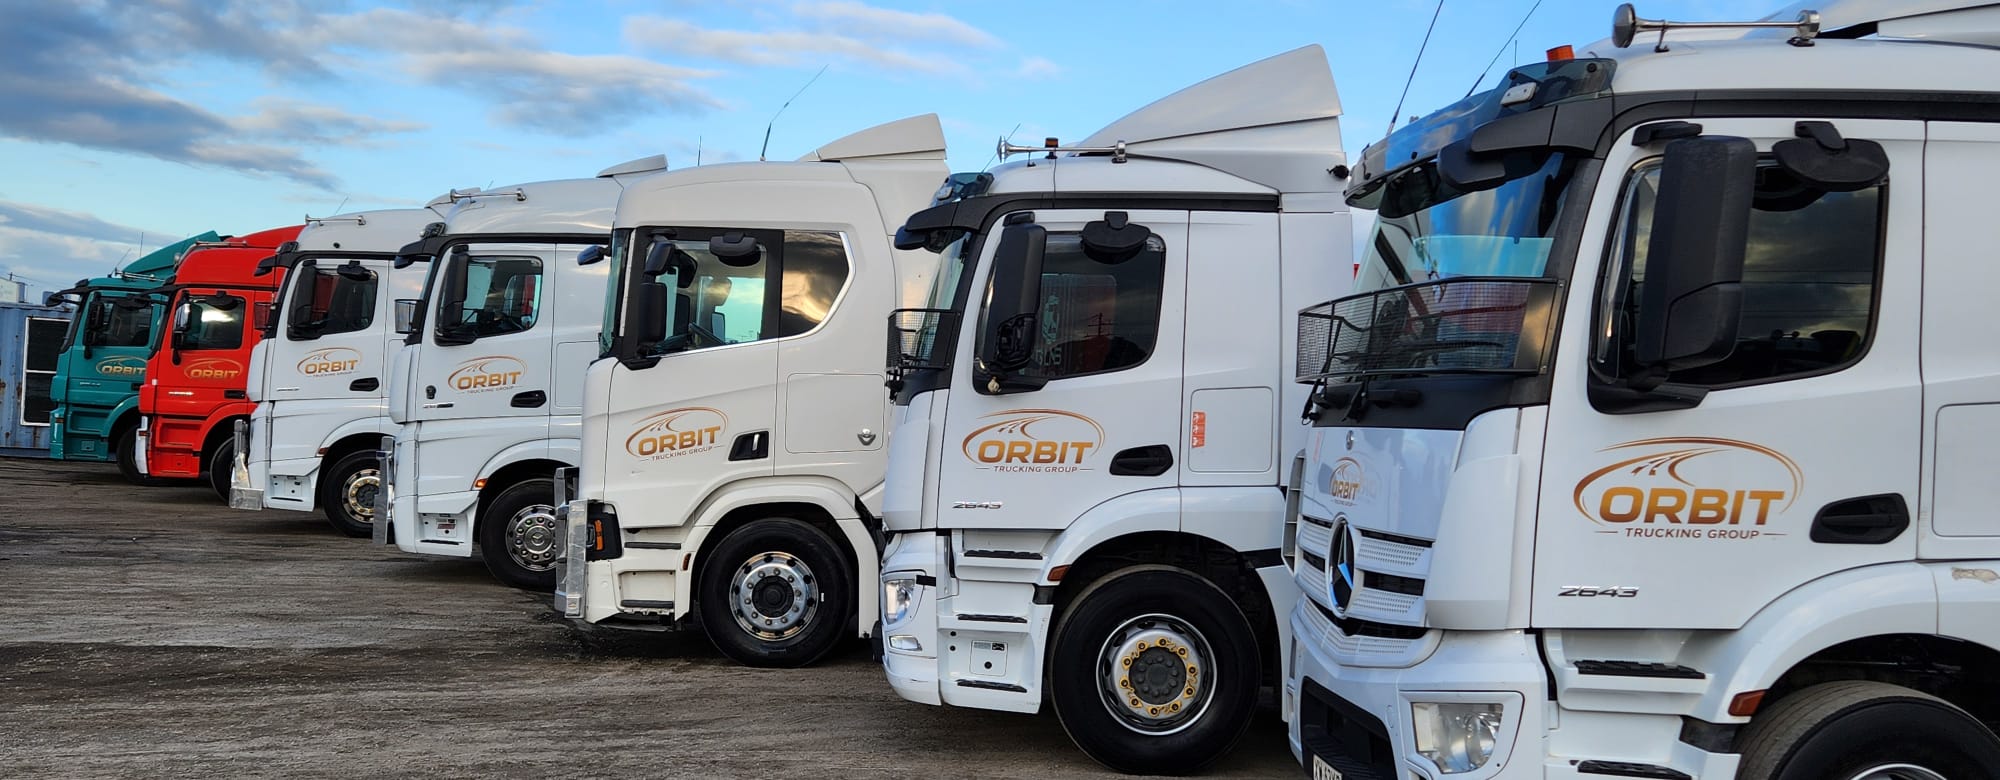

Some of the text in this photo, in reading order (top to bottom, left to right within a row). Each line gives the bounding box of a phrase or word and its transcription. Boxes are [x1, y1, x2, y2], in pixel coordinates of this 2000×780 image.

[102, 365, 147, 375] ORBIT
[191, 369, 239, 379] ORBIT
[305, 360, 358, 374] ORBIT
[457, 371, 521, 390] ORBIT
[638, 426, 721, 456] ORBIT
[652, 446, 713, 461] TRUCKING GROUP
[978, 440, 1094, 464] ORBIT
[994, 465, 1042, 473] TRUCKING
[1332, 480, 1360, 501] ORBIT
[952, 501, 1004, 510] 2643
[1599, 486, 1785, 526] ORBIT
[1625, 528, 1760, 540] TRUCKING GROUP
[1558, 585, 1640, 598] 2643
